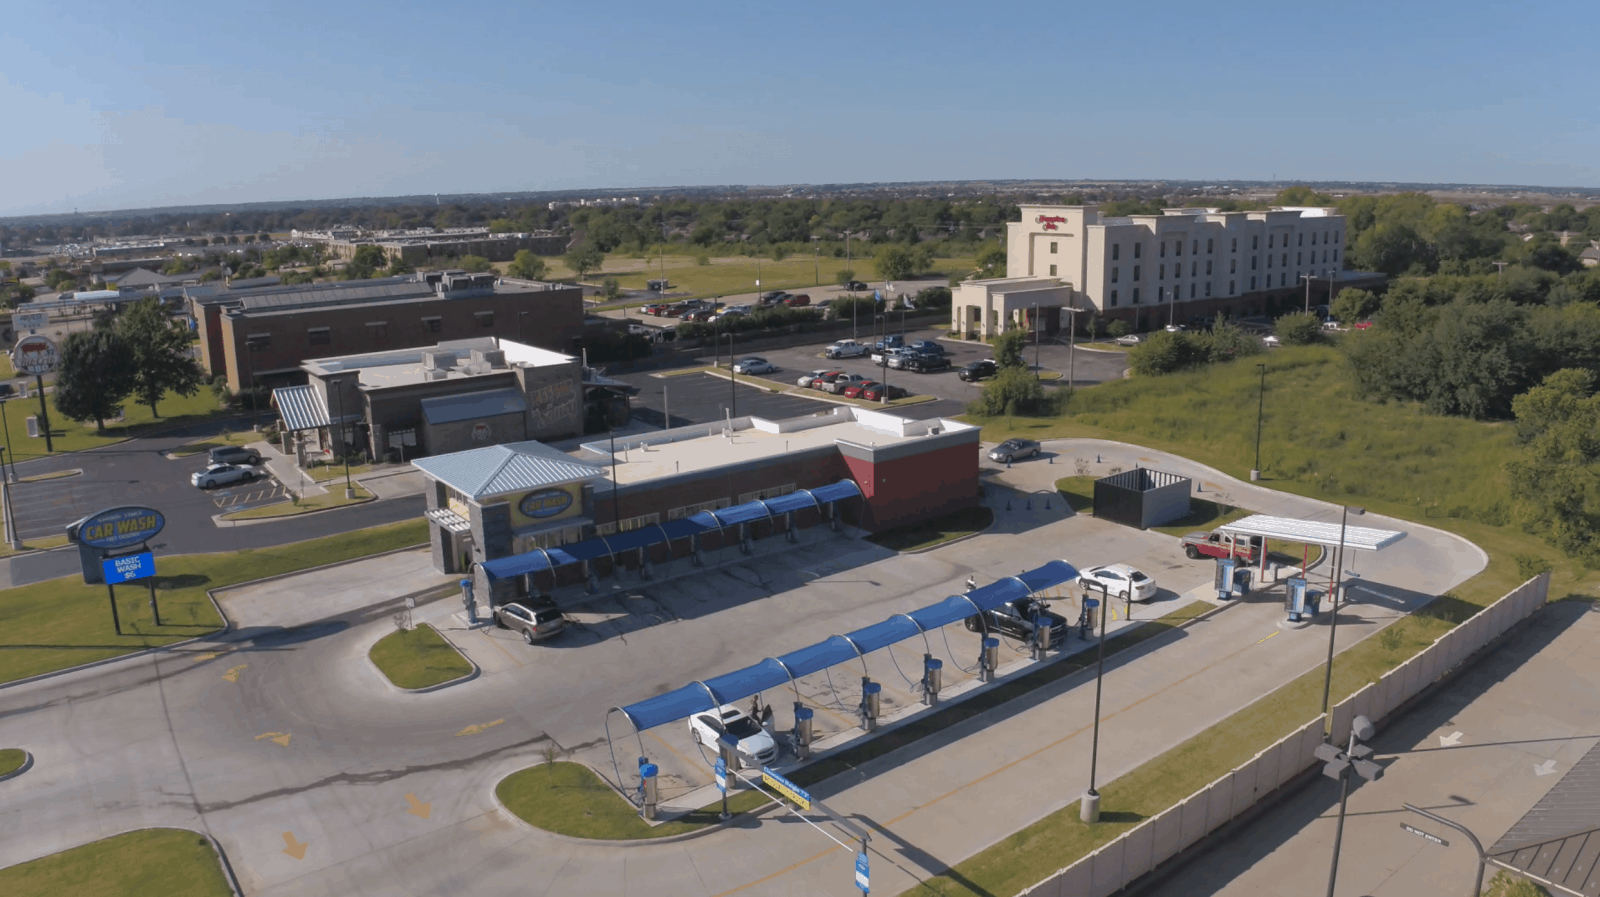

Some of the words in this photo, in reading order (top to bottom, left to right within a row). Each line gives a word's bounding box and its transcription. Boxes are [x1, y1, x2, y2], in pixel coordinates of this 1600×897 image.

[86, 523, 114, 541] CAR
[117, 515, 157, 534] WASH
[115, 556, 140, 567] BASIC
[117, 563, 142, 573] WASH
[1413, 829, 1425, 837] NOT
[1424, 833, 1442, 844] ENTER
